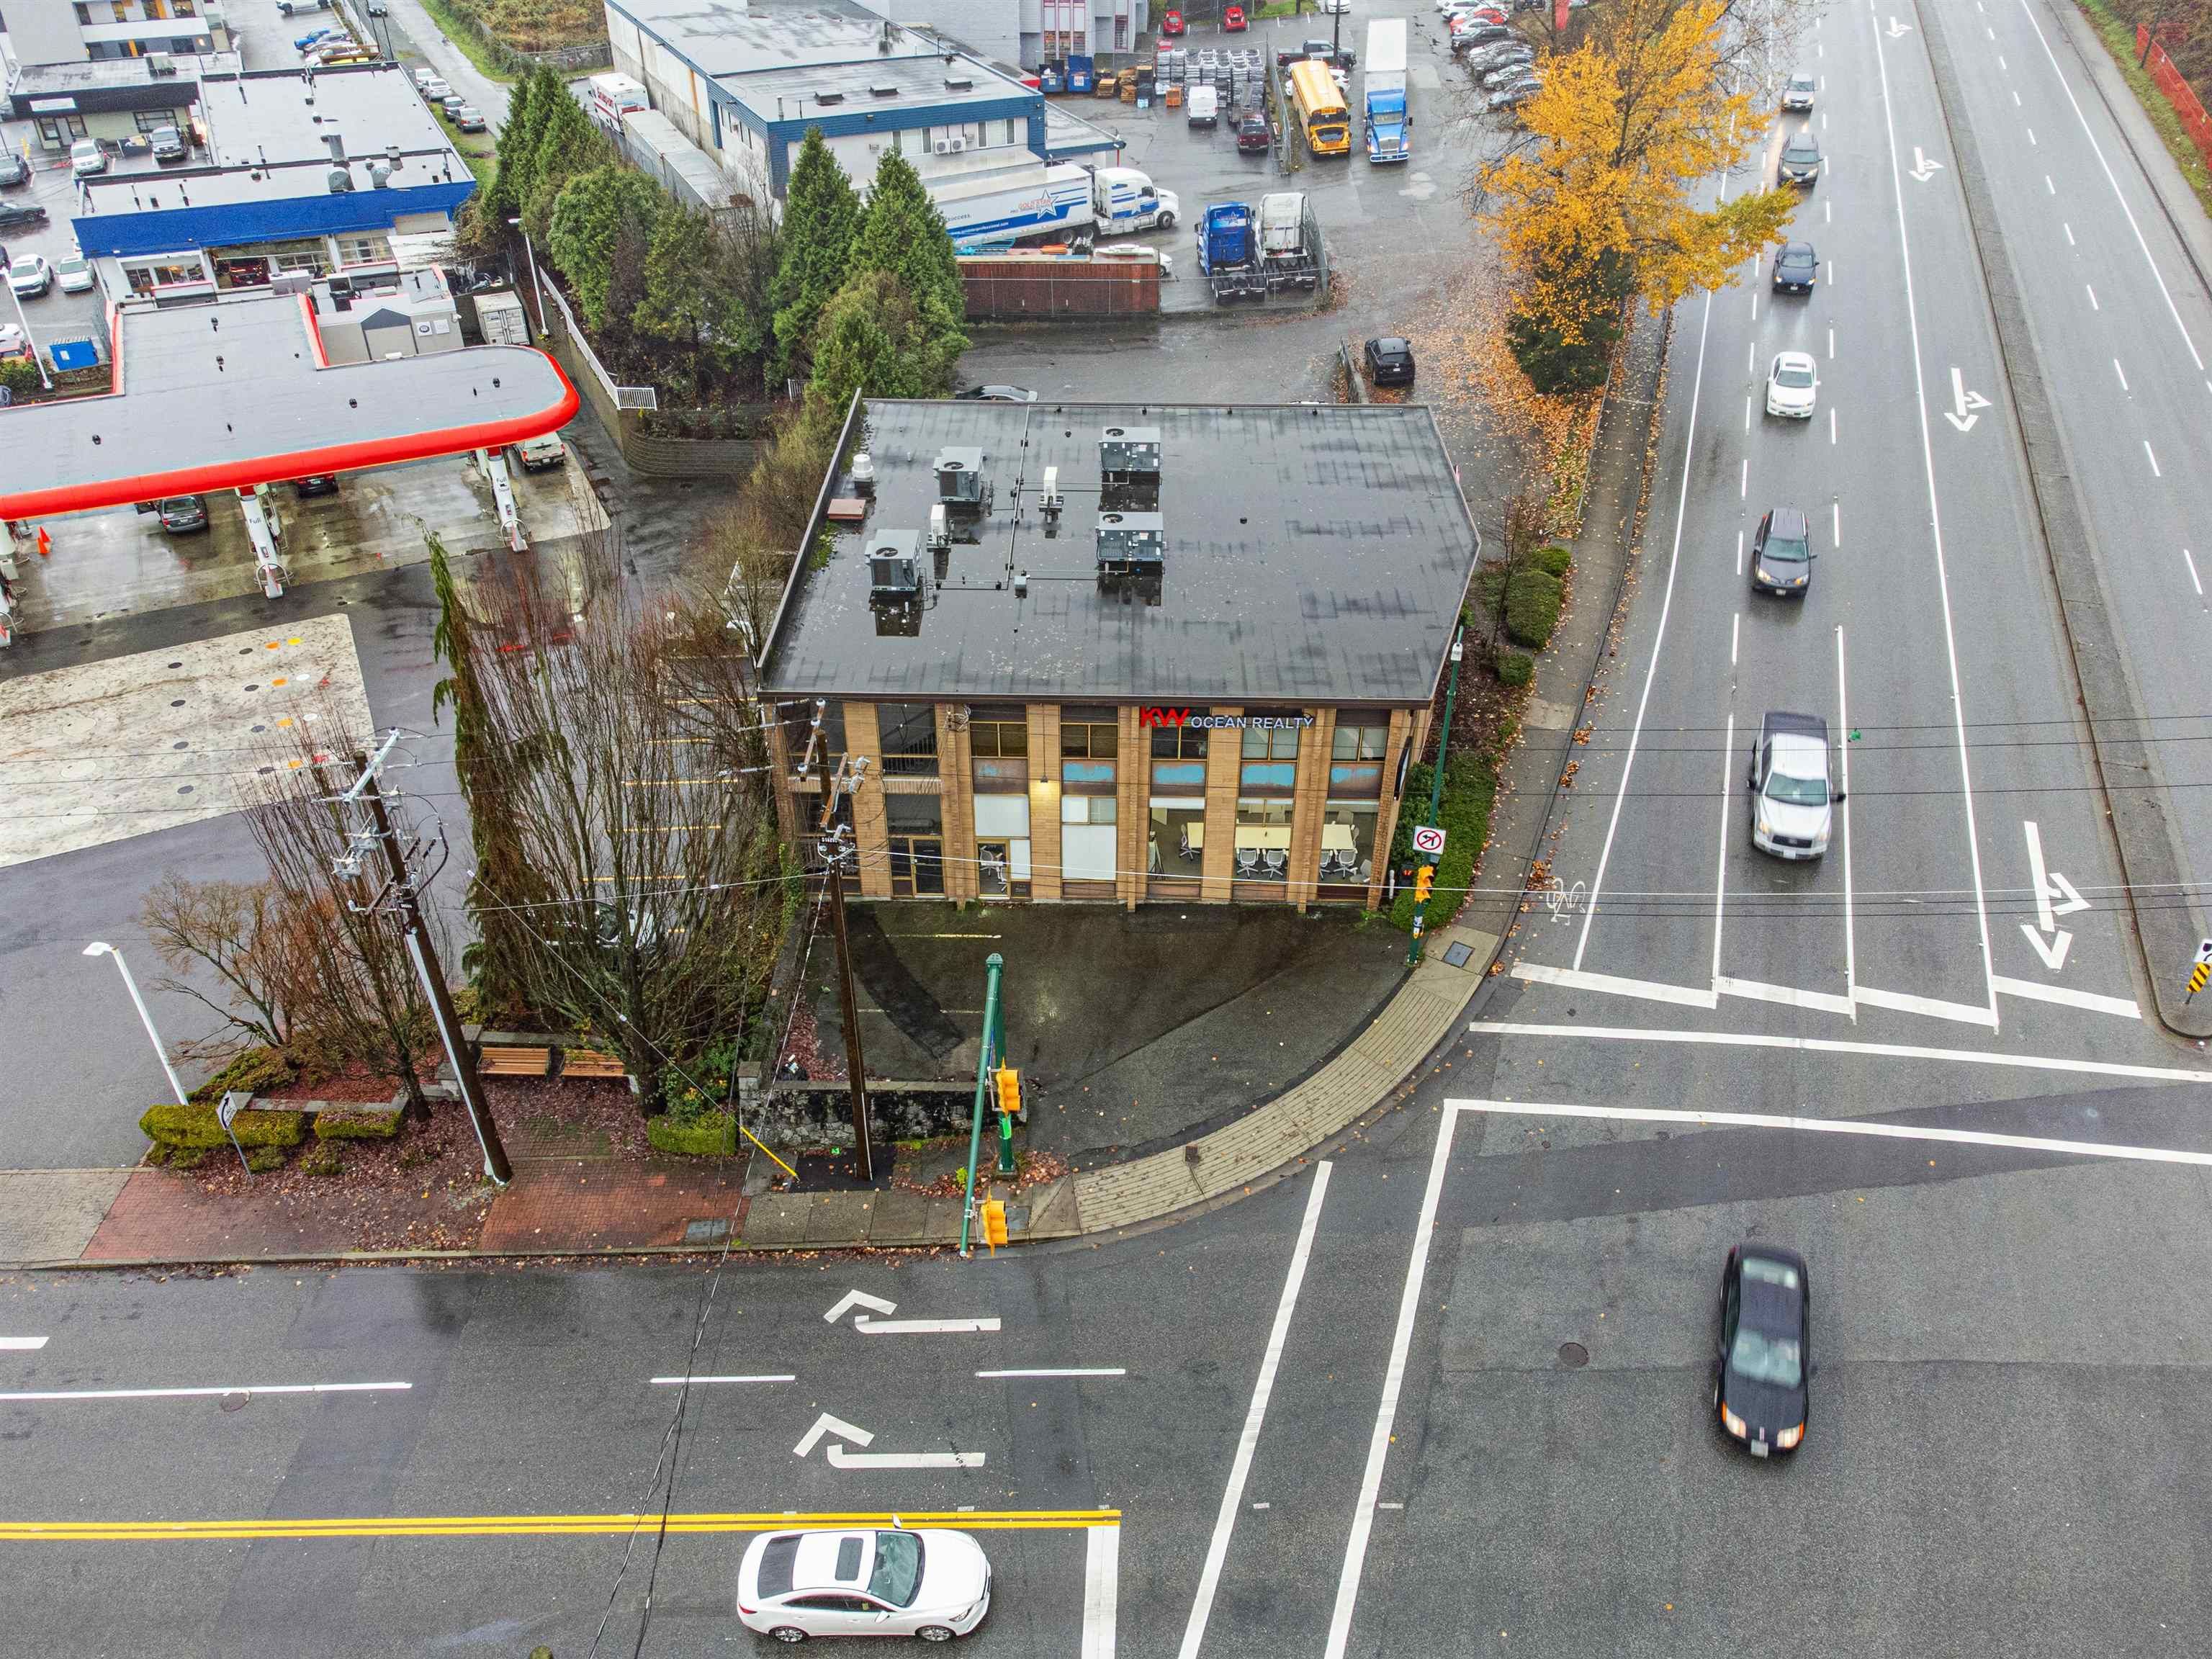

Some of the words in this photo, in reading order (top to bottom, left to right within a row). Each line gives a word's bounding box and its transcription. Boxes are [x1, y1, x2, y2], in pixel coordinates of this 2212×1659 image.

[1140, 706, 1189, 727] KW
[1191, 716, 1246, 729] OCEAN
[1252, 716, 1313, 729] REALTY
